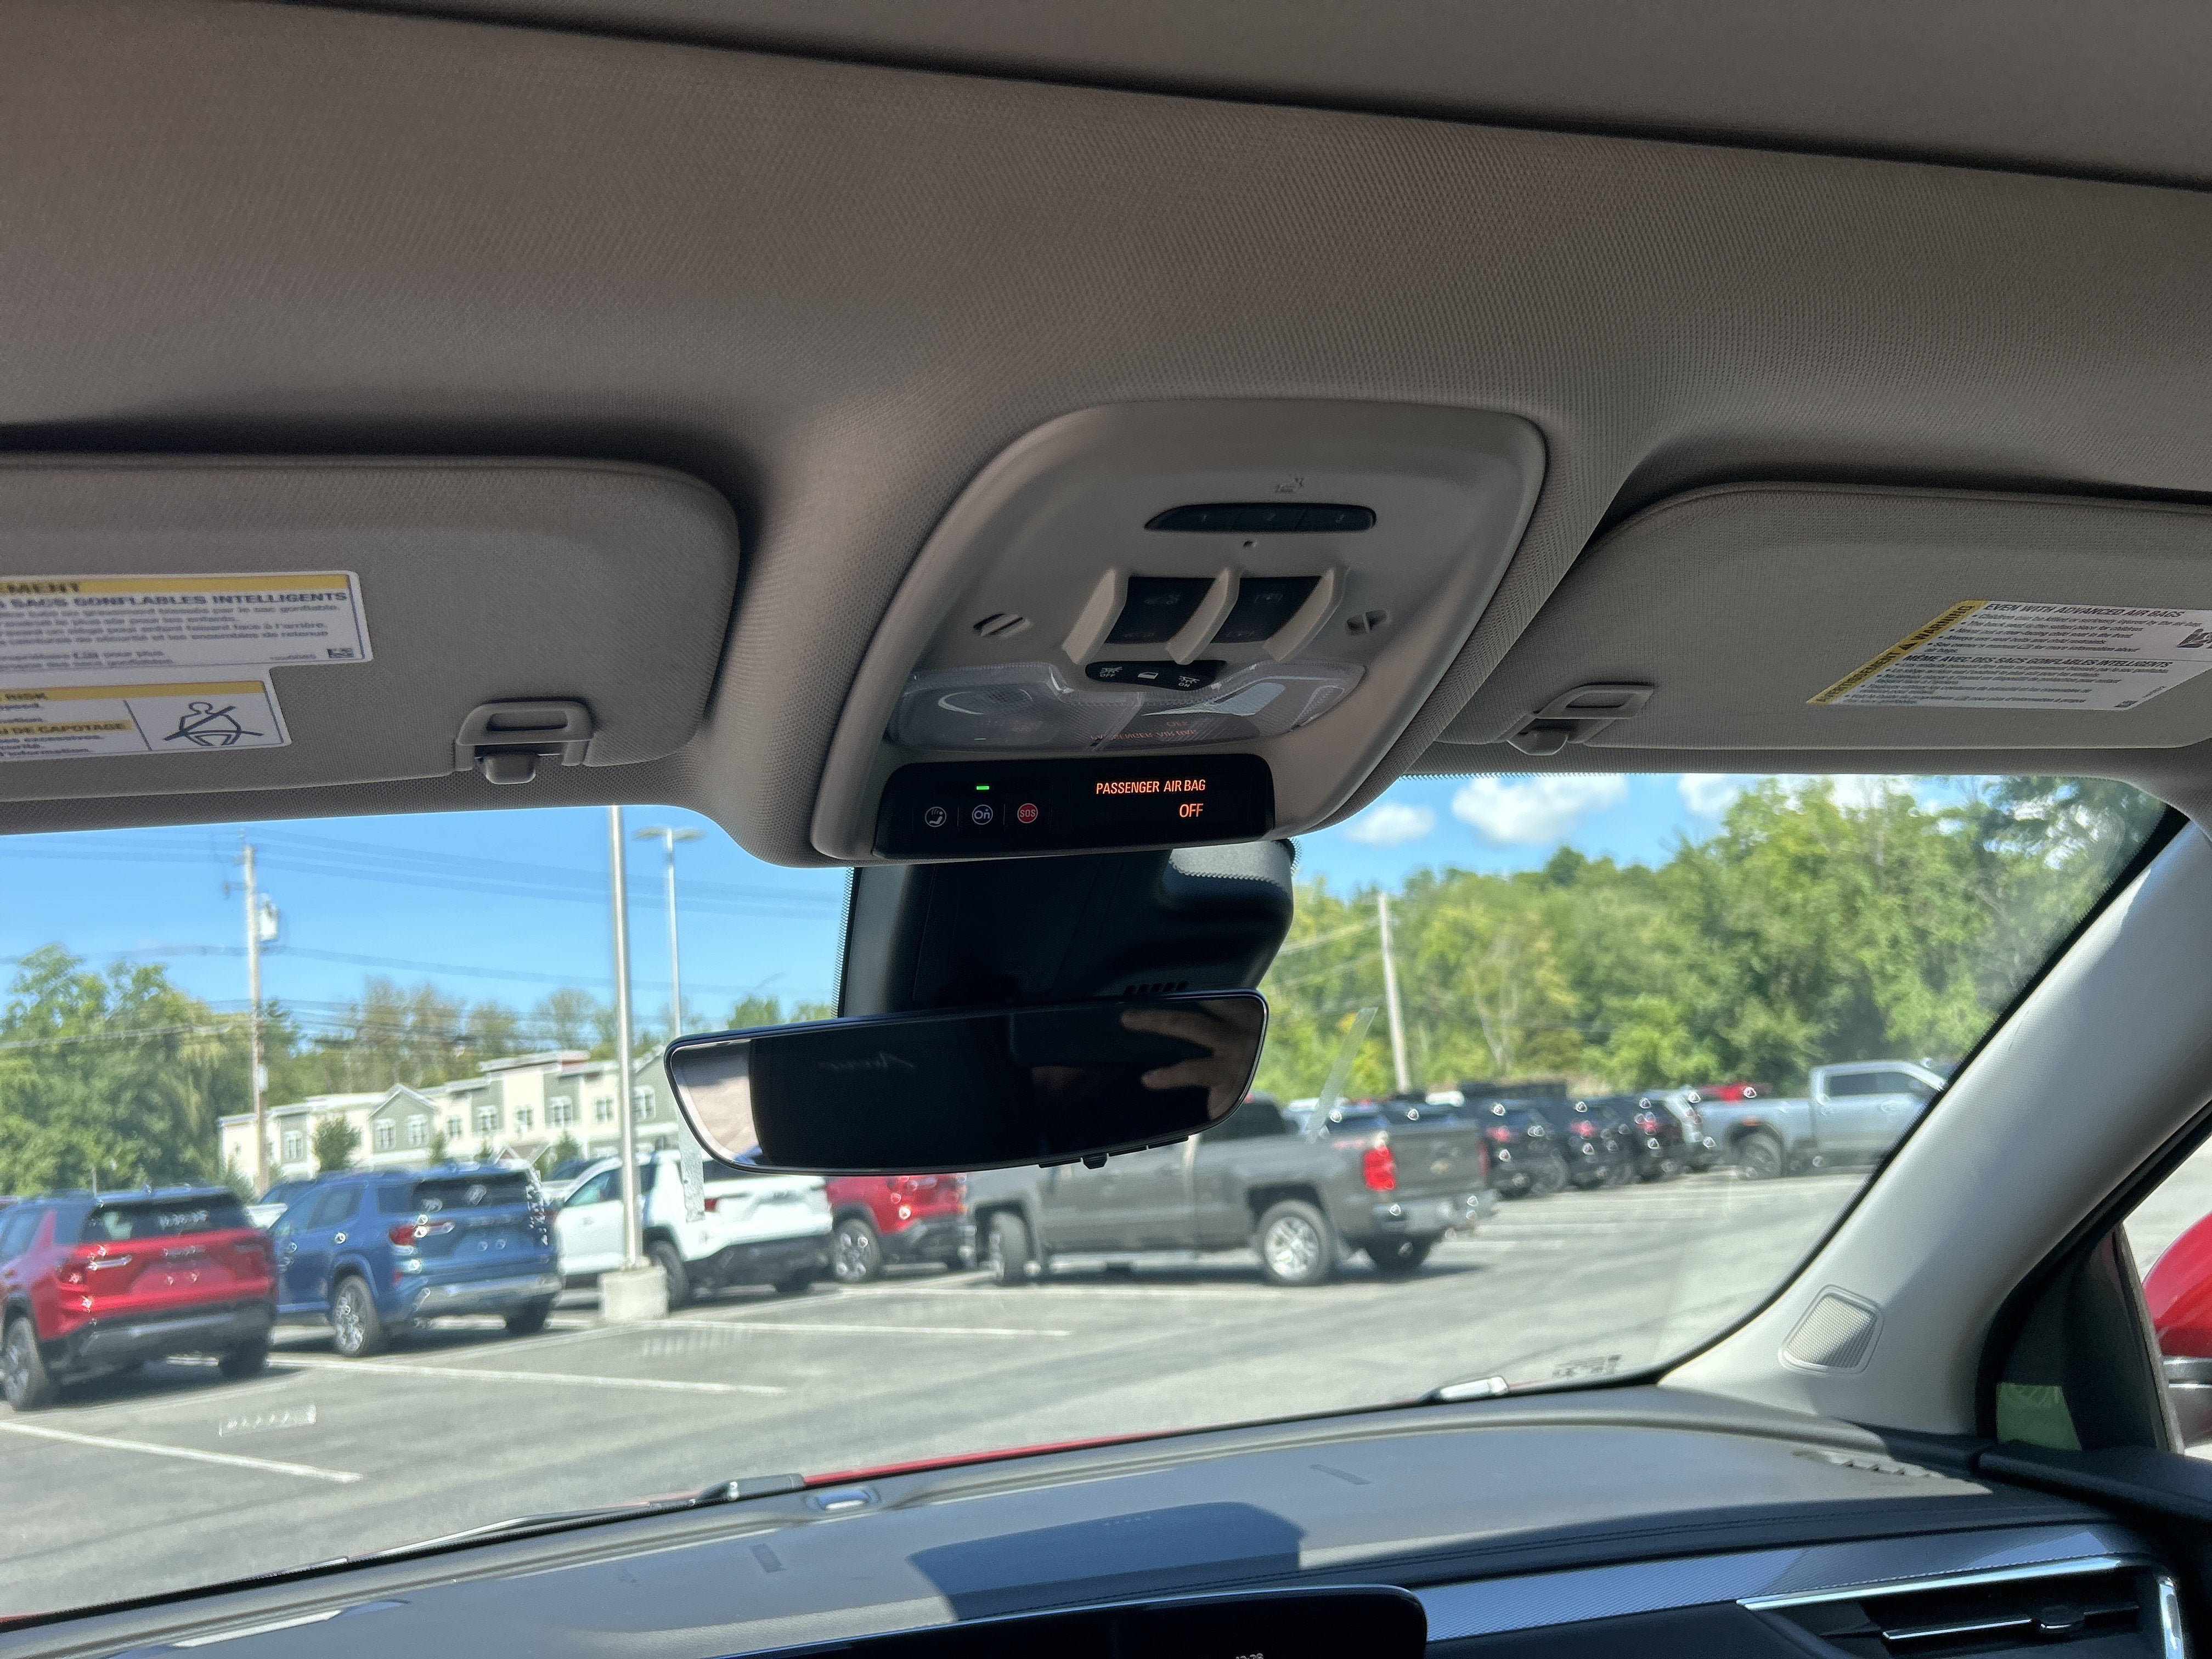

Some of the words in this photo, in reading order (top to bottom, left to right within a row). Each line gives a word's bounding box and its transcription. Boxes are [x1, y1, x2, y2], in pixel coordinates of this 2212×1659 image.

[213, 592, 348, 604] INTELLIGENTS
[1983, 603, 2022, 612] EVEN
[2019, 605, 2058, 613] WITH
[2053, 606, 2126, 616] ADVANCED
[1911, 605, 1975, 641] WARNING
[1096, 781, 1160, 794] PASSENGER
[1163, 780, 1182, 792] AIR
[1184, 779, 1206, 792] BAG
[1019, 809, 1036, 818] SOS
[1179, 803, 1204, 817] OFF
